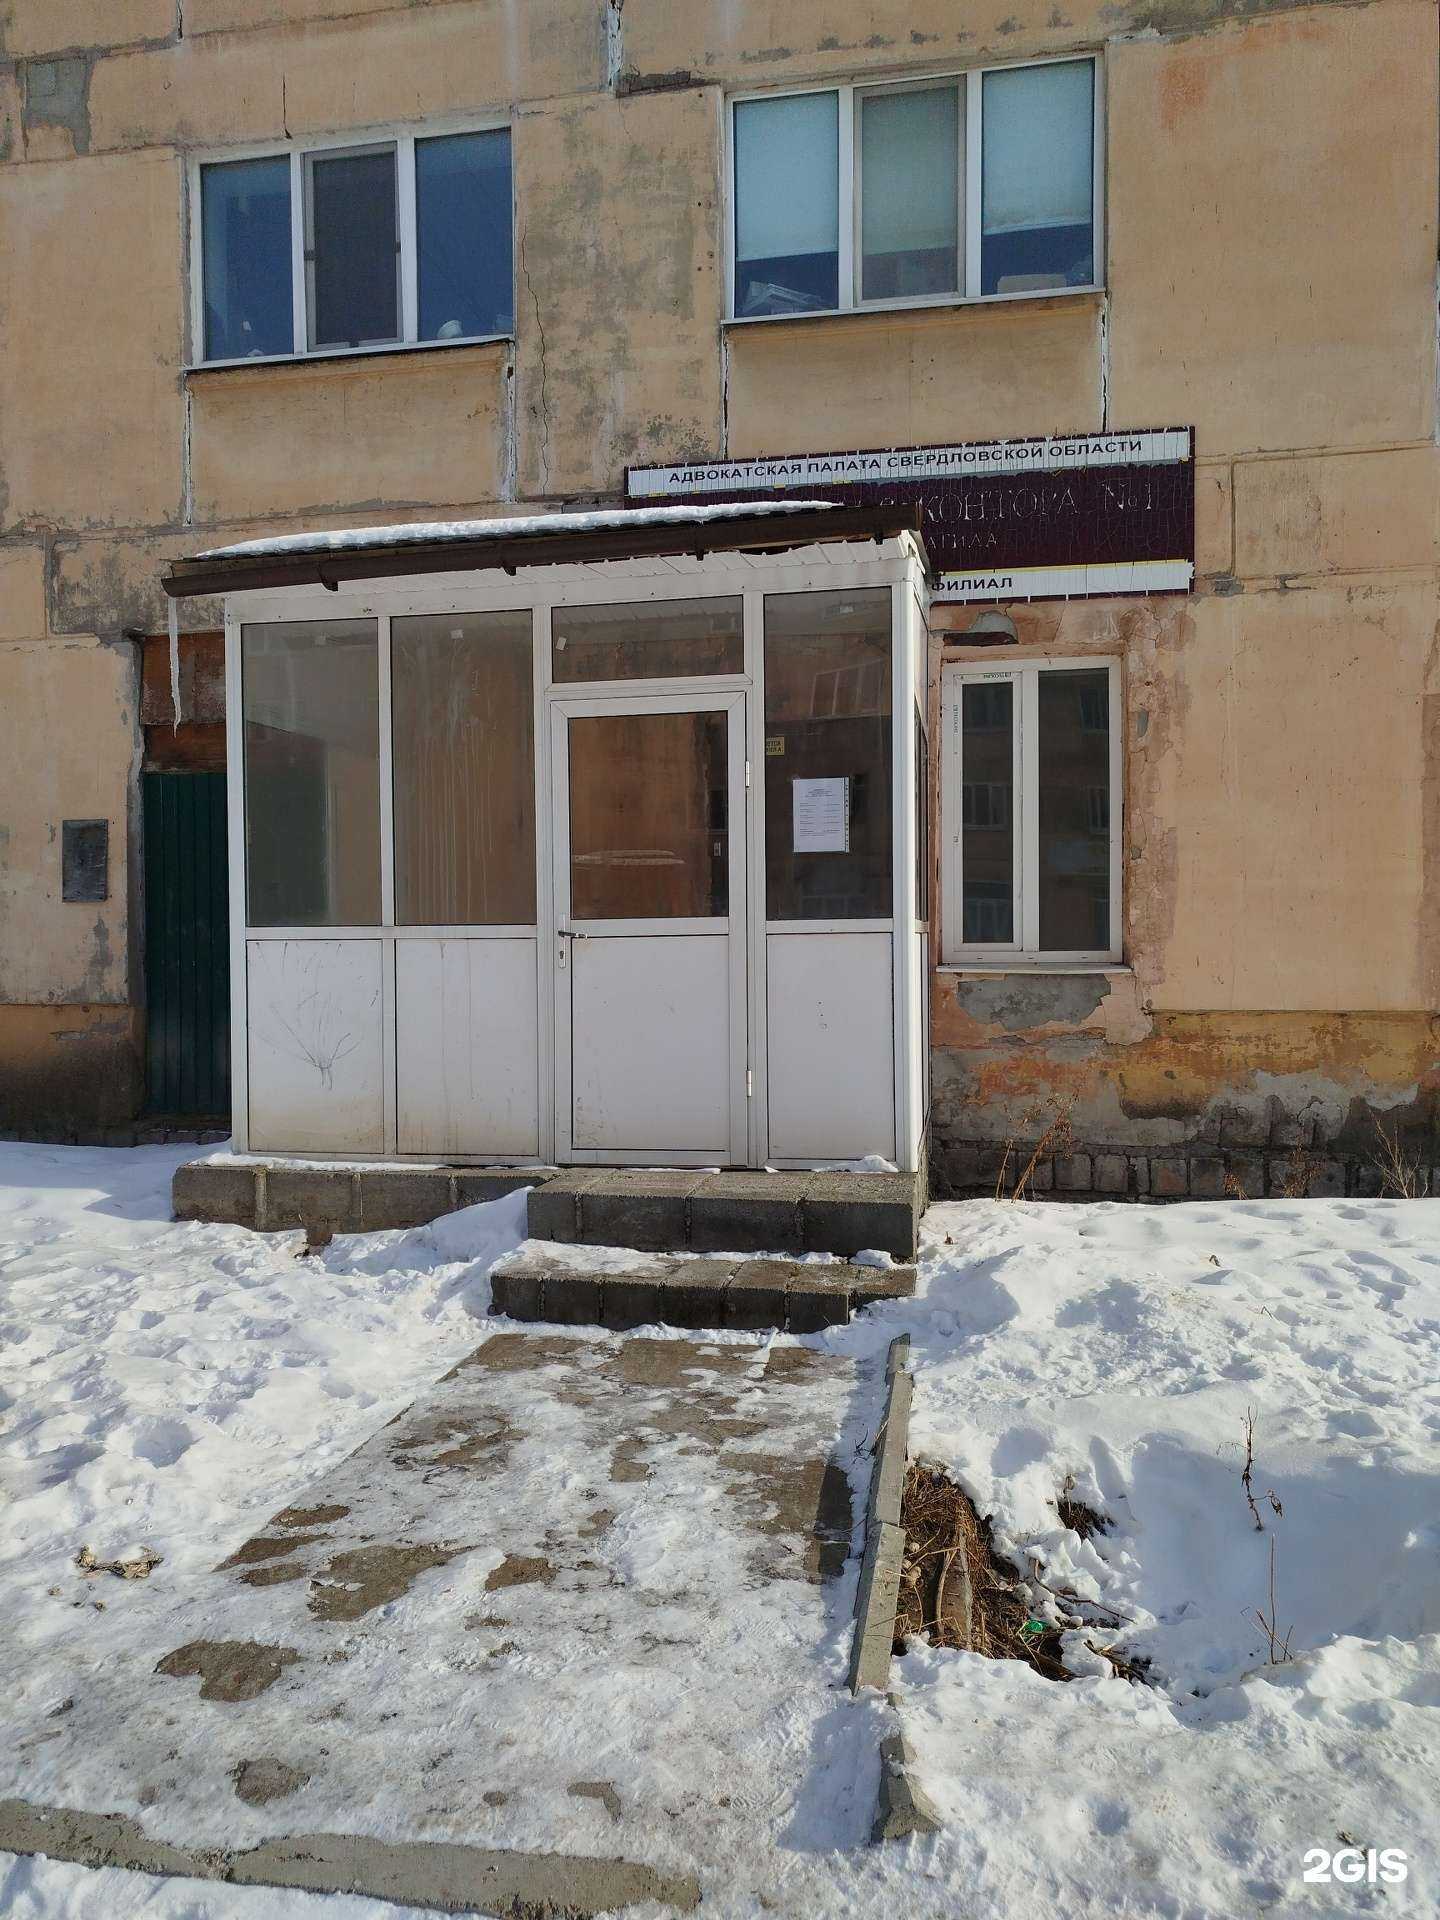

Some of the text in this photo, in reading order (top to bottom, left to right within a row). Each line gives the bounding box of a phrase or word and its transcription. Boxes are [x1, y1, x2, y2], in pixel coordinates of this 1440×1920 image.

[669, 440, 1142, 484] АДВОКАТСКАЯ ПАЛАТА СВЕРДЛОВСКОЙ ОБЛАСТИ
[925, 531, 998, 549] АГИЛА
[932, 577, 1013, 592] ФИЛИАЛ
